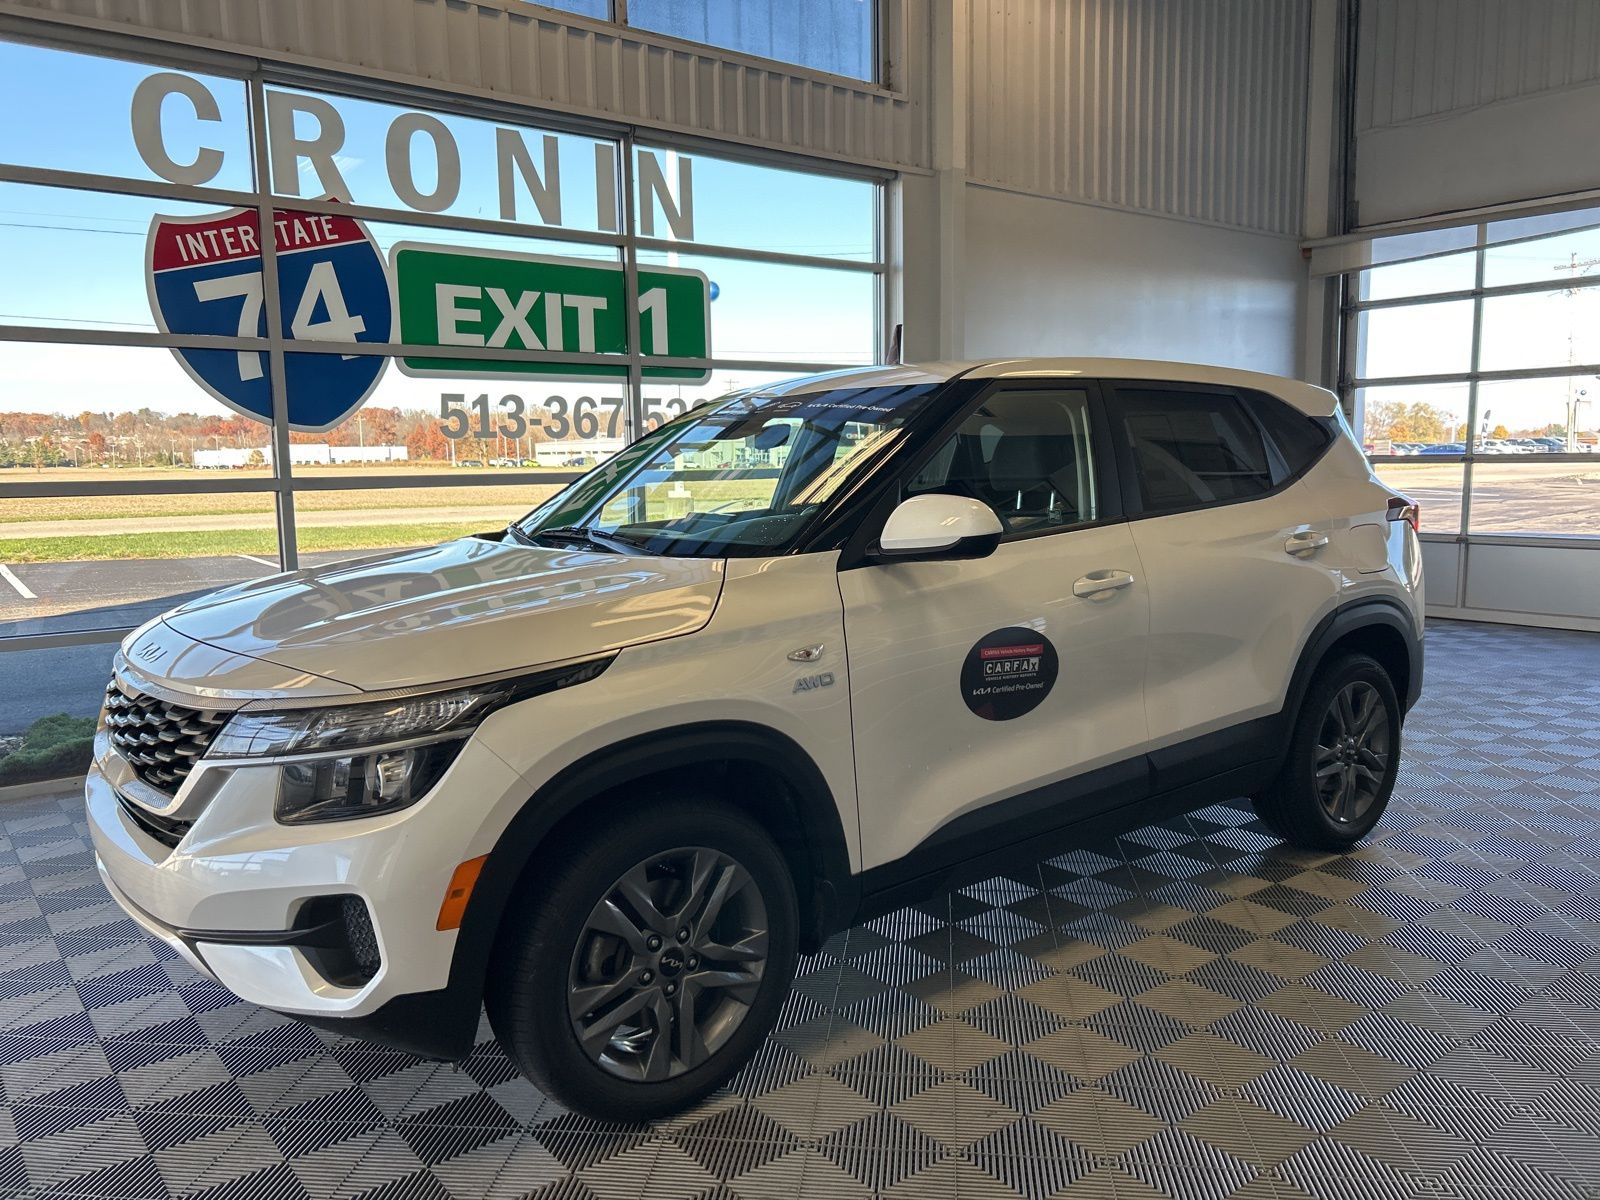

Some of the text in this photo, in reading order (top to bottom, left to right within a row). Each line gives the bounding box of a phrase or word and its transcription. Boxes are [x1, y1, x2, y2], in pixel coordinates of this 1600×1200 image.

[131, 72, 694, 241] CRONIN
[175, 215, 339, 262] INTERTATE
[192, 261, 367, 382] 74
[435, 283, 669, 355] EXIT 1
[792, 672, 835, 693] AWD
[985, 659, 1039, 674] CARFAX
[992, 685, 1015, 694] Certified
[1015, 682, 1044, 691] Pre-Owned
